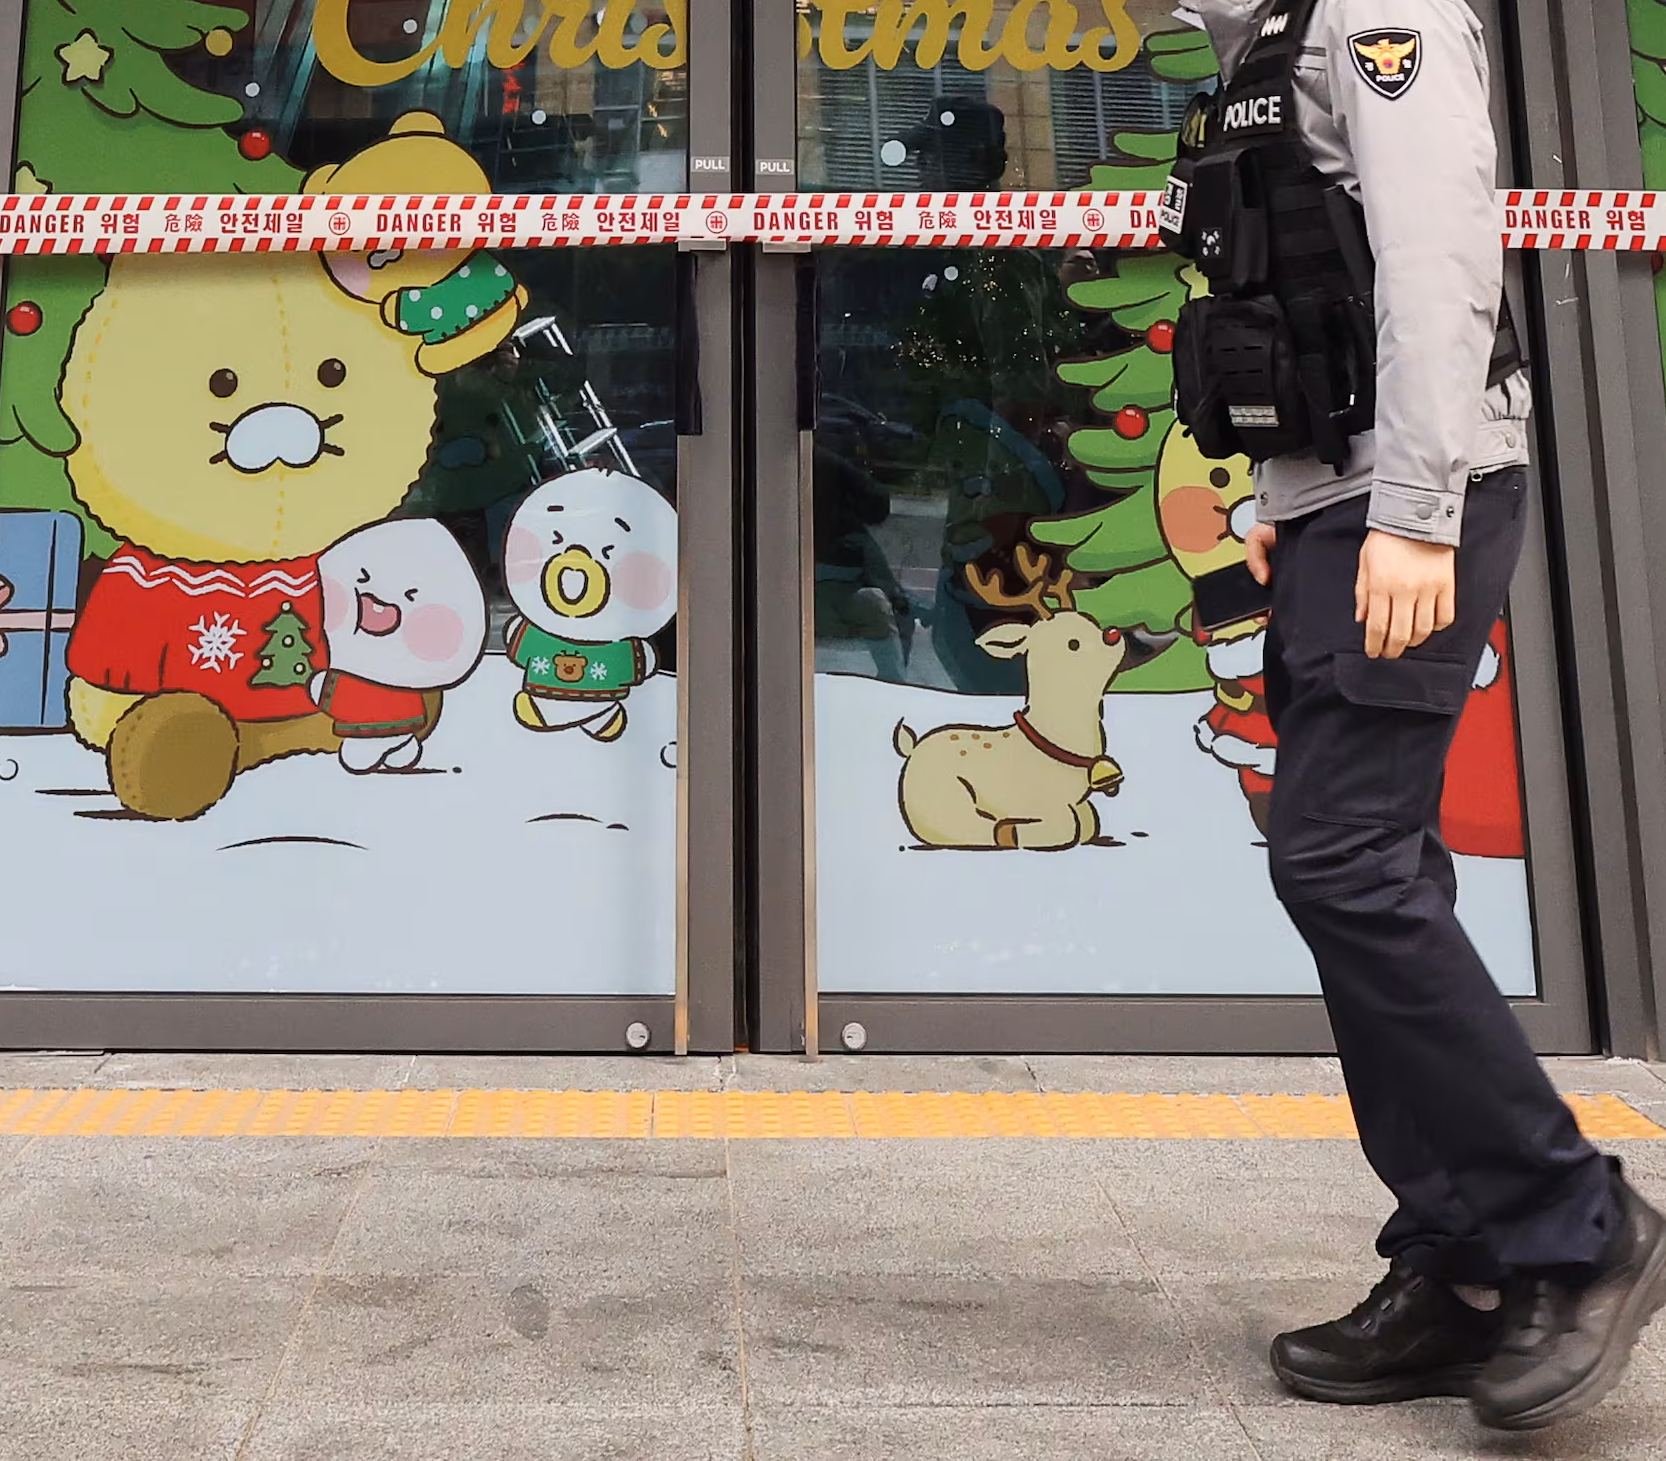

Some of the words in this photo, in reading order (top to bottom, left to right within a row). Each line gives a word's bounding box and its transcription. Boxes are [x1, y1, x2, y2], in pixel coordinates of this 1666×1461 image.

[1223, 96, 1281, 131] POLICE
[694, 159, 726, 170] PULL
[759, 161, 791, 173] PULL
[0, 214, 85, 234] DANGER
[100, 213, 140, 234] 위험
[220, 213, 304, 234] 안전제일
[376, 213, 462, 232] DANGER
[477, 212, 517, 234] 위험
[596, 212, 680, 233] 안전제일
[753, 211, 839, 231] DANGER
[854, 211, 894, 232] 위험
[973, 210, 1057, 231] 안전제일
[1504, 209, 1591, 229] DANGER
[1606, 210, 1646, 231] 위험
